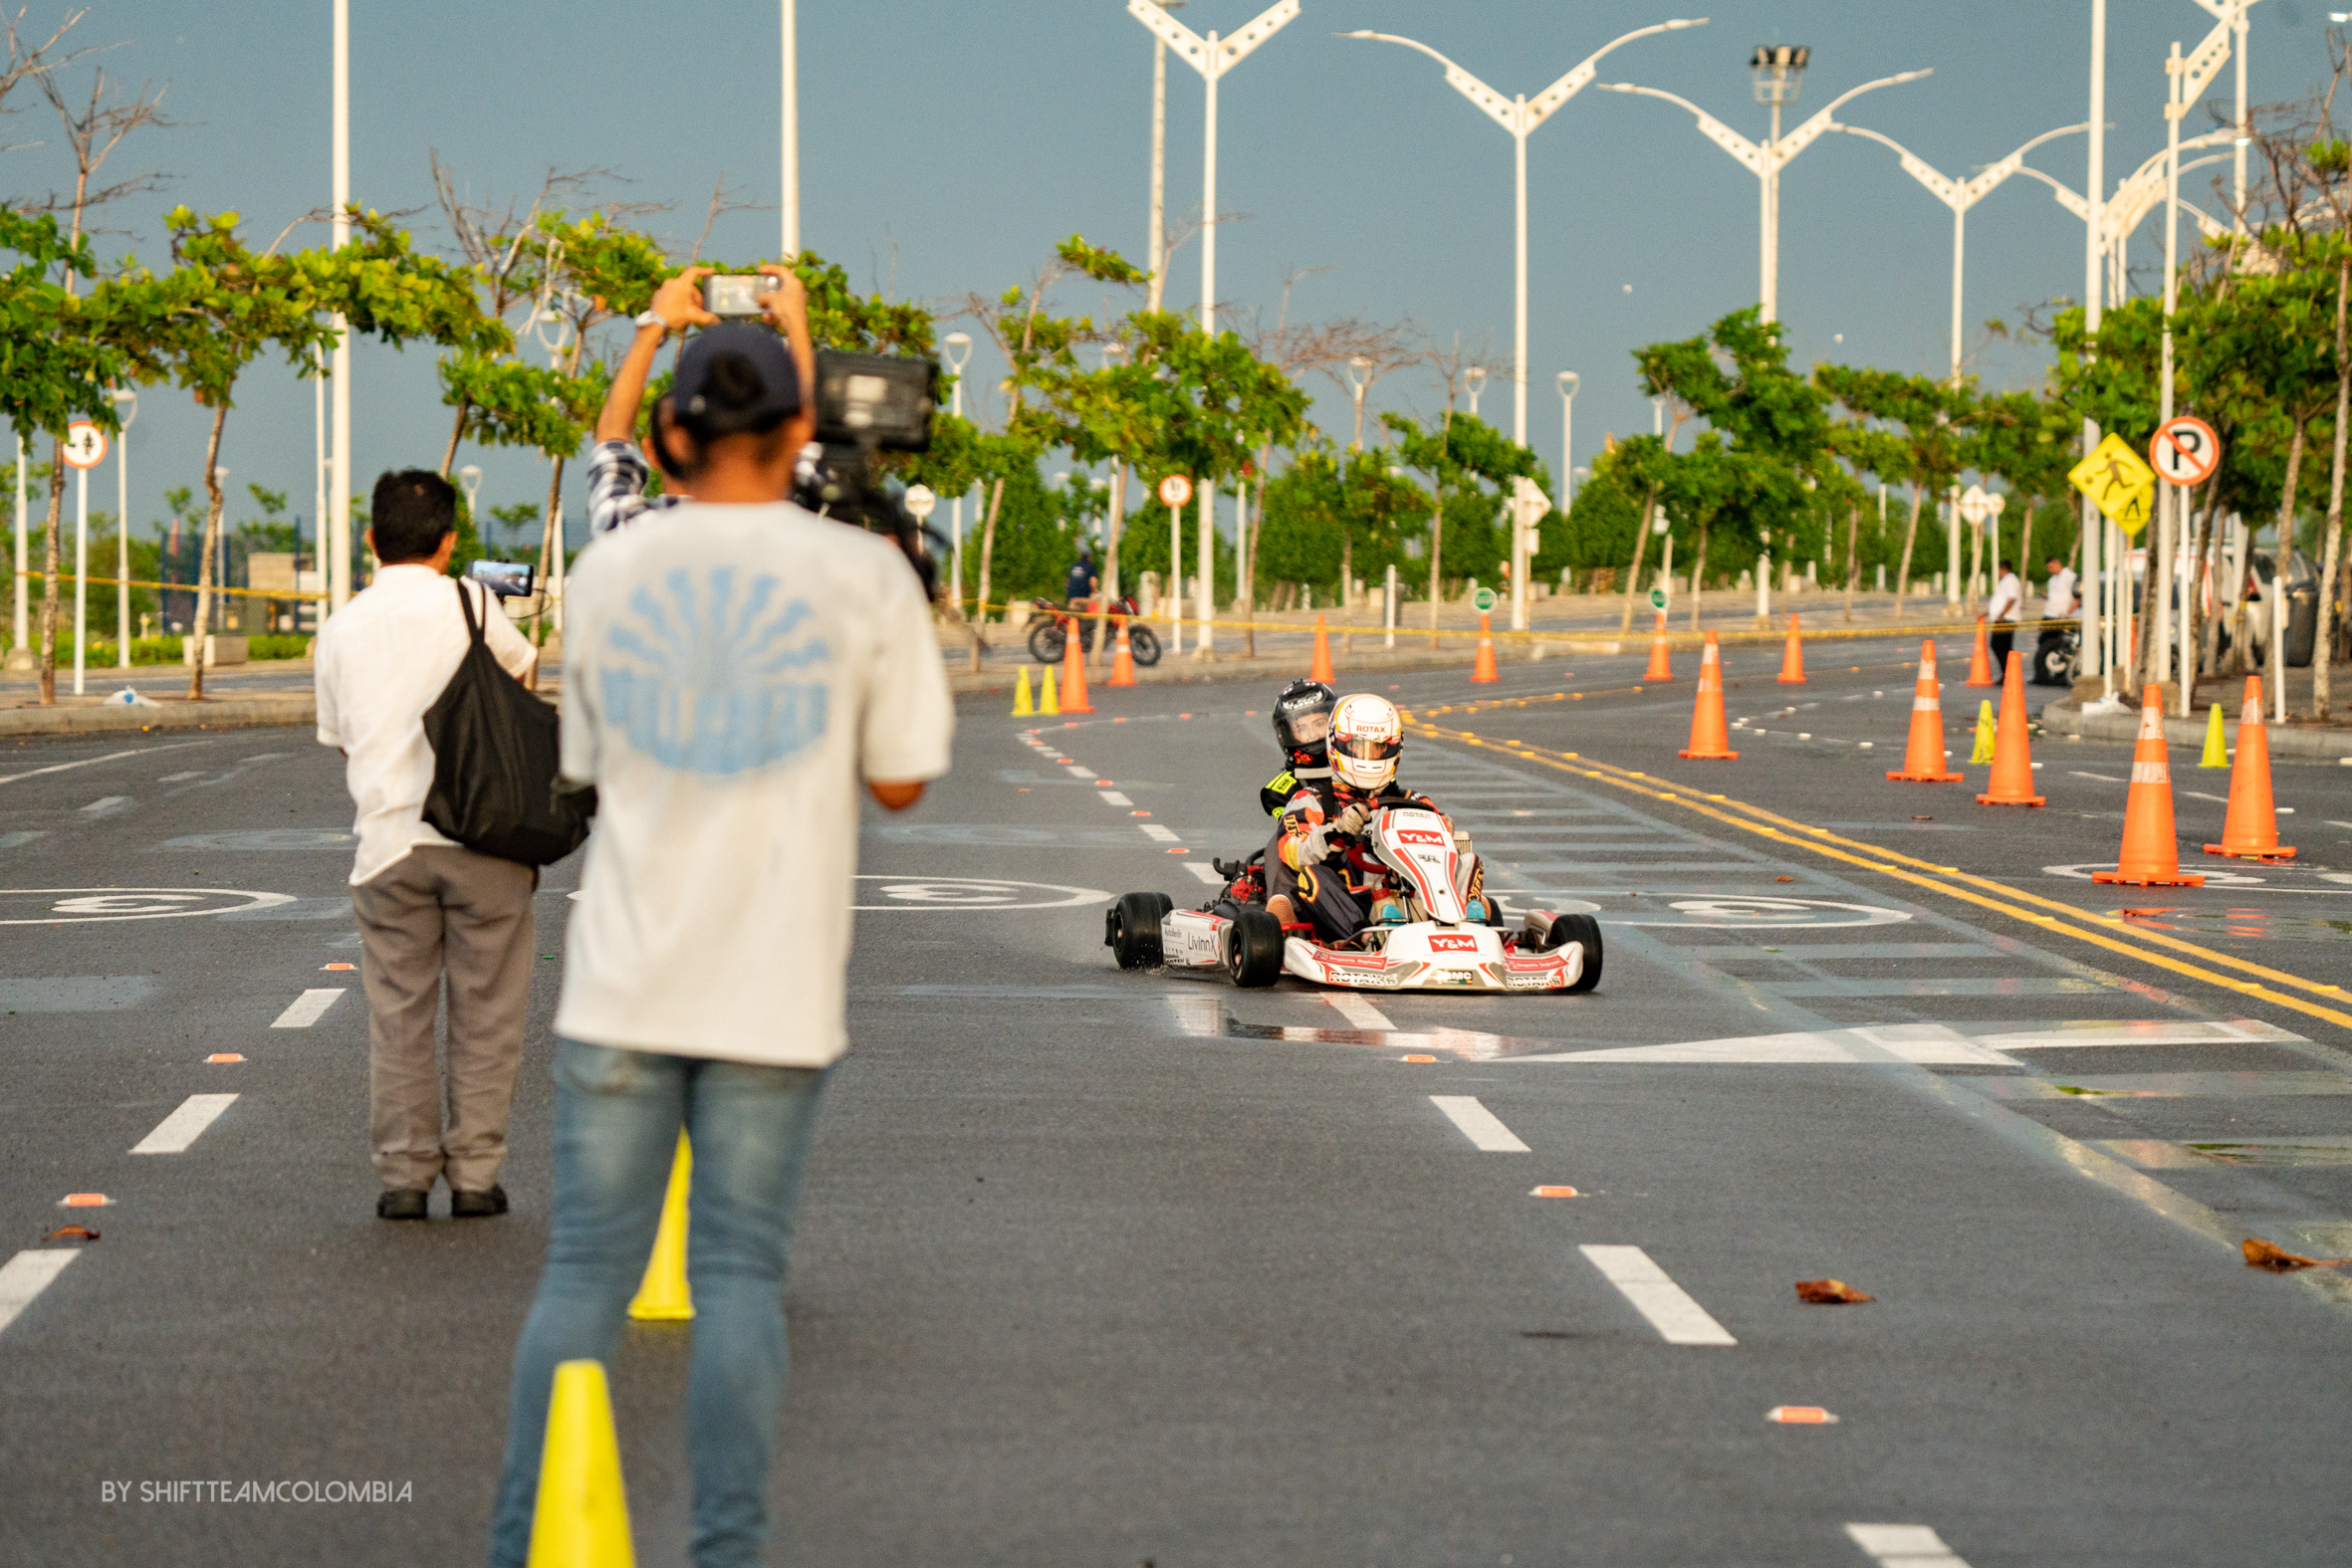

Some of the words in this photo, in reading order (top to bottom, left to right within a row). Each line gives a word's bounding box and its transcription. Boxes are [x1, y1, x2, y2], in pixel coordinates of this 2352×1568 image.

[2173, 431, 2201, 470] P
[1356, 725, 1386, 734] ROTAX
[1400, 832, 1444, 844] Y&M
[1187, 932, 1218, 958] LivinnX
[1431, 938, 1476, 949] Y&M
